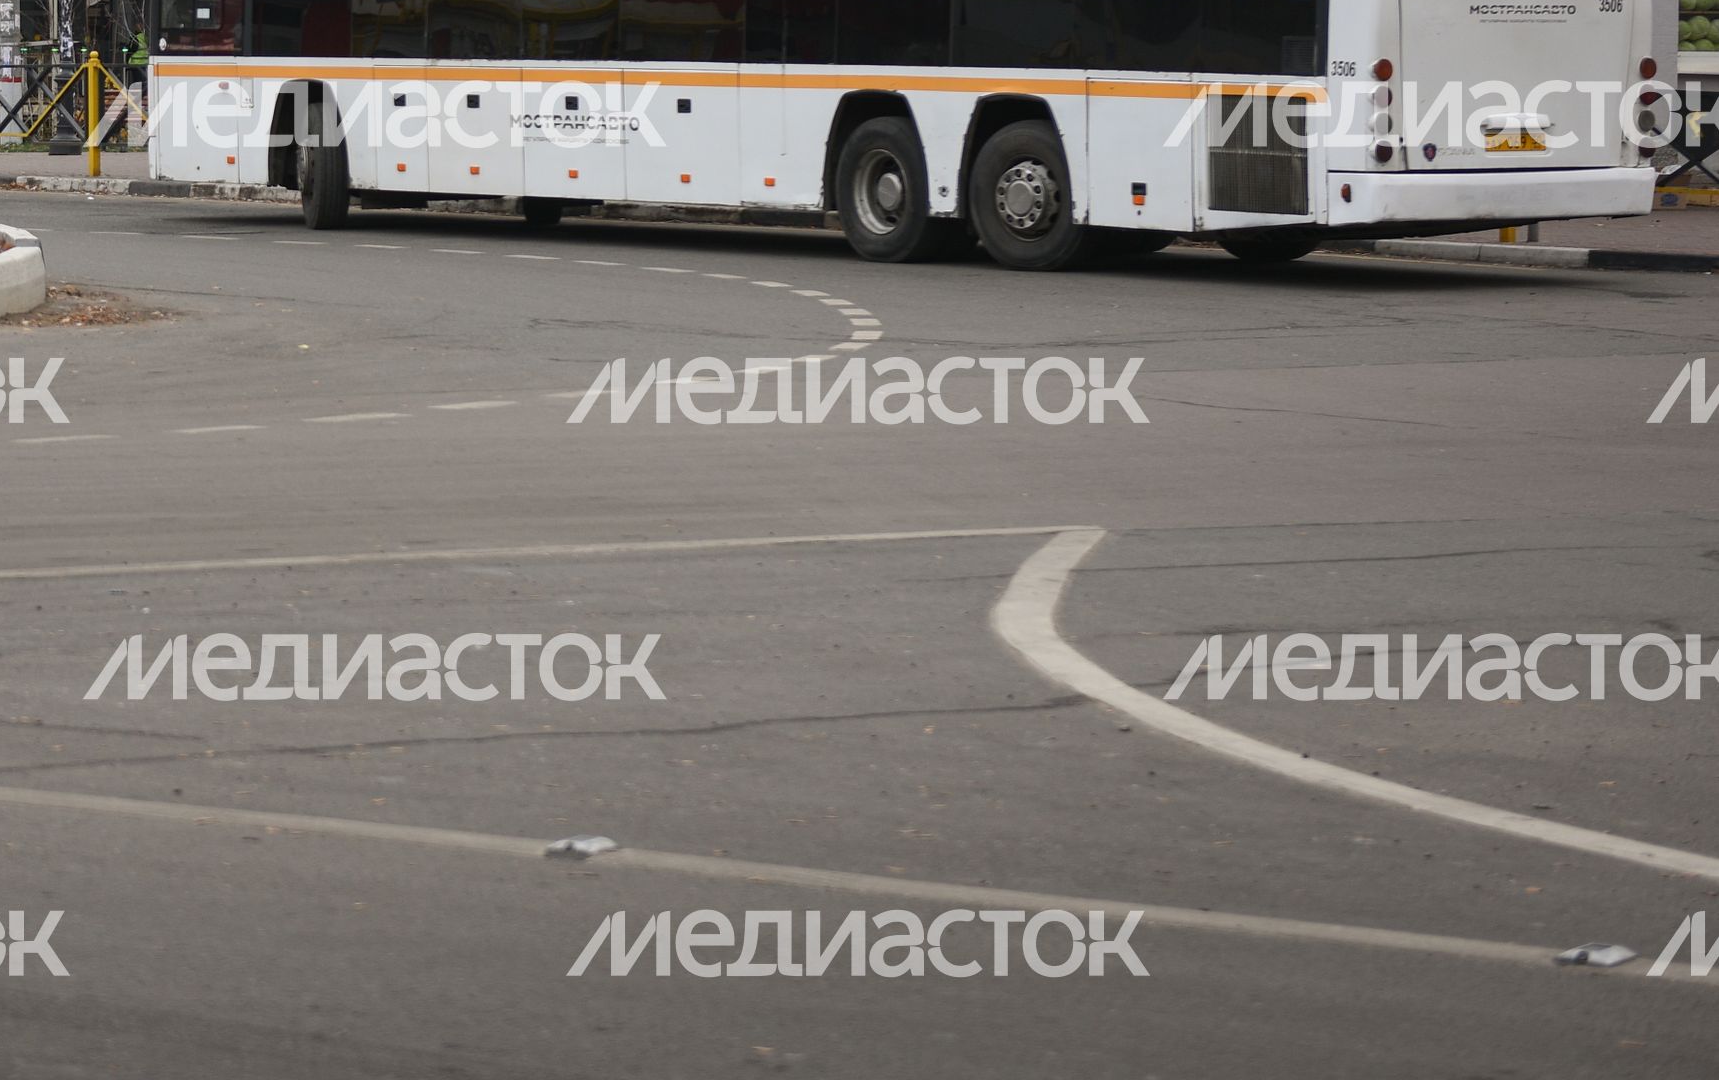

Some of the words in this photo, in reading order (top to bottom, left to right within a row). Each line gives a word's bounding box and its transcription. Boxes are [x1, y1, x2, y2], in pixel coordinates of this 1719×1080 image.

[1469, 5, 1576, 15] МОСТРАНСАВТО
[1330, 60, 1357, 77] 3506
[510, 114, 640, 131] МОСТРАНСАВТО
